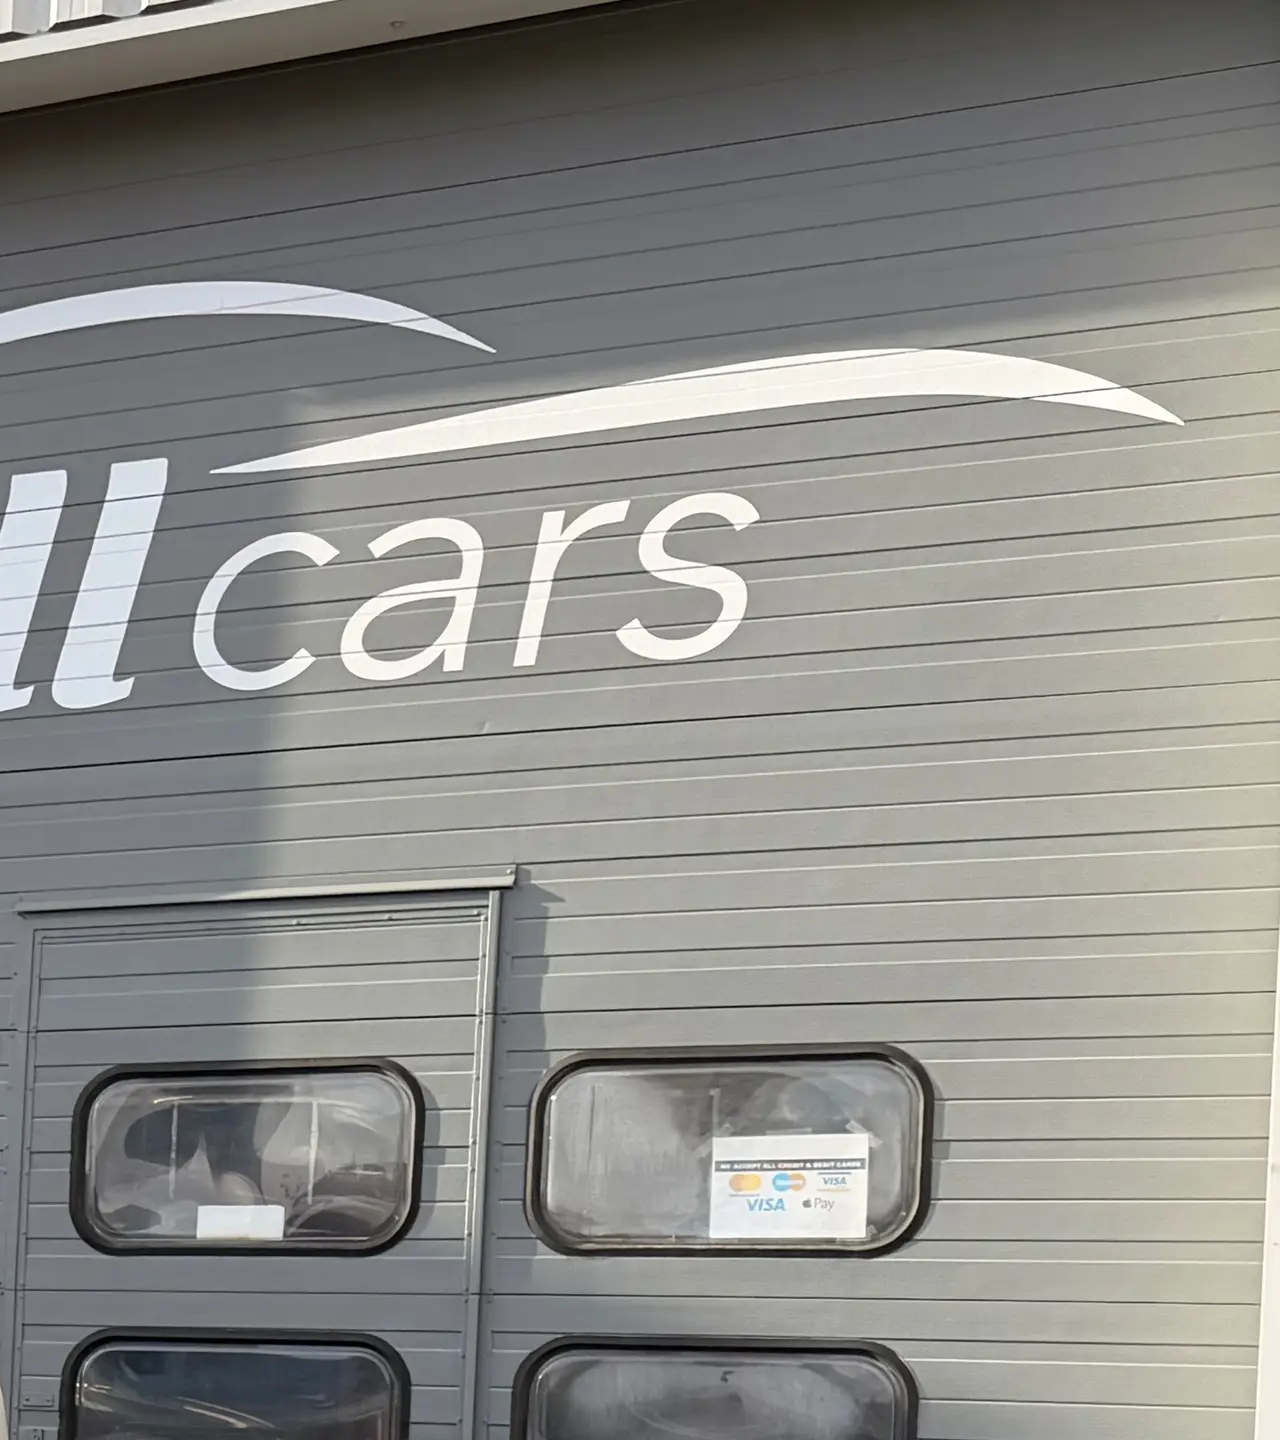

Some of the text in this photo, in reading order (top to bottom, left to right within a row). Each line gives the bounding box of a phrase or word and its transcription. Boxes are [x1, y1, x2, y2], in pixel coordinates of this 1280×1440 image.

[193, 492, 760, 690] cars
[822, 1176, 848, 1186] VISA
[746, 1198, 786, 1212] VISA
[814, 1198, 836, 1212] Pay
